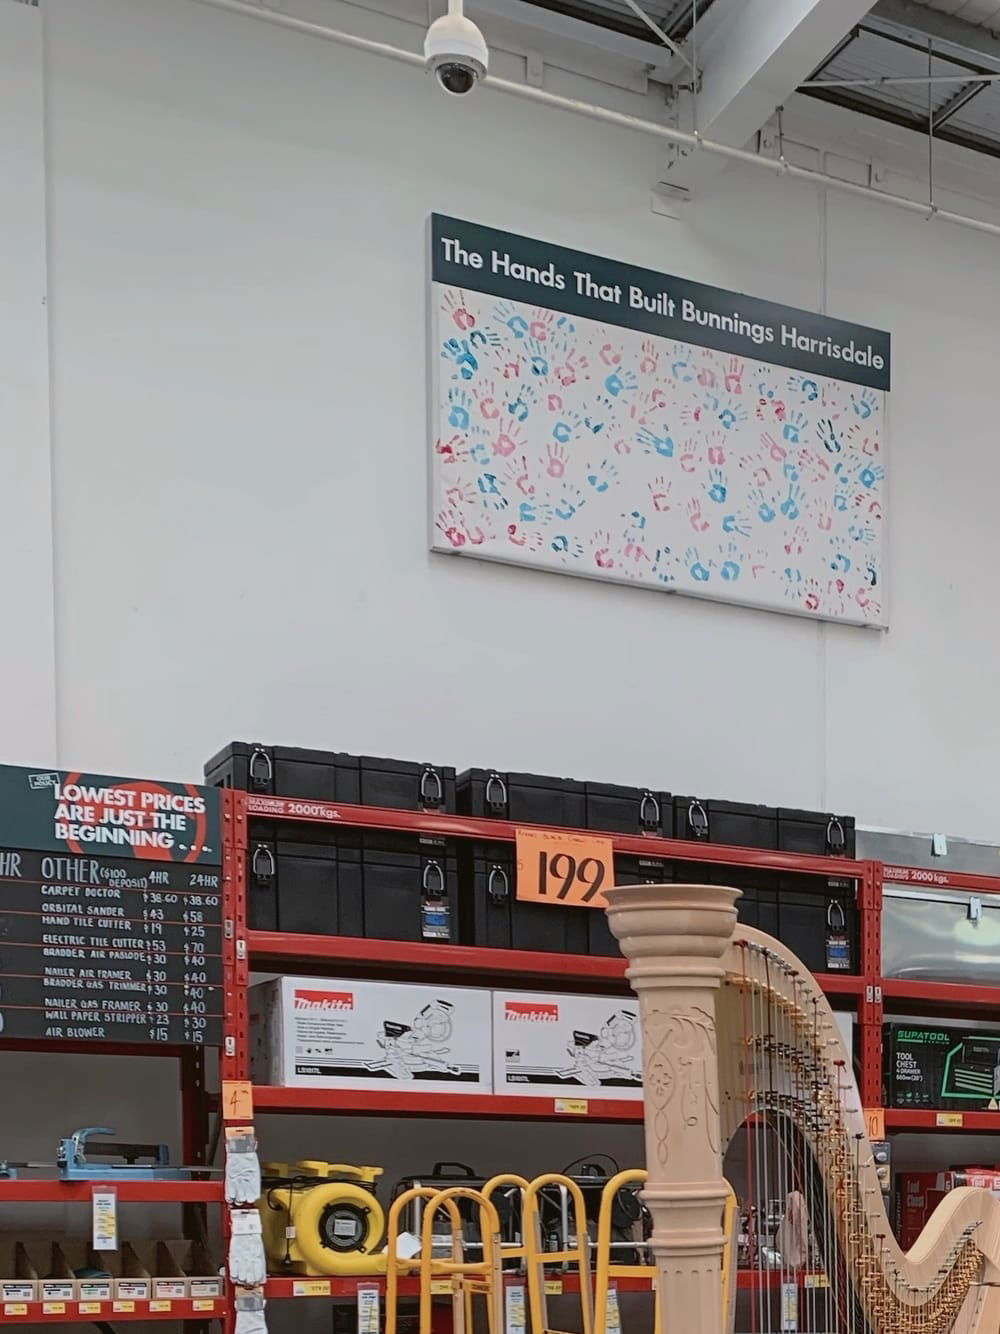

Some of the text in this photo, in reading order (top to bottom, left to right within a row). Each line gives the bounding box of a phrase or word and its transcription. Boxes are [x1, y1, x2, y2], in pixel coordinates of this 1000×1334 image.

[441, 237, 884, 370] The Hands That Built Bunnings Harrisdale
[54, 783, 206, 814] LOWEST PRICES
[54, 803, 186, 831] ARE JUST THE
[41, 857, 100, 884] OTHER
[148, 871, 170, 884] 4HR
[189, 874, 218, 888] 24HR
[539, 851, 605, 903] 199
[911, 871, 933, 880] 2000
[41, 885, 80, 896] CARPET
[85, 887, 120, 898] DOCTOR
[42, 903, 83, 914] ORBITAL
[87, 905, 125, 917] SANDER
[42, 916, 70, 926] HAND
[73, 917, 94, 927] TILE
[98, 919, 131, 930] CUTTER
[42, 934, 85, 945] ELECTRIC
[90, 937, 108, 947] TILE
[112, 938, 144, 949] CUTTER
[43, 948, 86, 959] BRADDER
[90, 950, 105, 959] AIR
[44, 967, 75, 978] NAILER
[79, 968, 96, 978] AIR
[97, 969, 132, 980] FRAMER
[43, 978, 84, 988] BRADDER
[86, 979, 104, 989] GAS
[109, 981, 147, 992] TRIMMER
[44, 998, 77, 1009] NAILER
[81, 1000, 98, 1009] GAS
[102, 1000, 142, 1011] FRAMER
[45, 1011, 68, 1020] WALL
[71, 1011, 100, 1022] PAPER
[104, 1013, 147, 1024] STRIPPER
[45, 1027, 63, 1038] AIR
[67, 1027, 105, 1038] BLOWER
[897, 1030, 950, 1041] SUPATOOL
[896, 1052, 914, 1060] TOOL
[896, 1060, 917, 1068] CHEST
